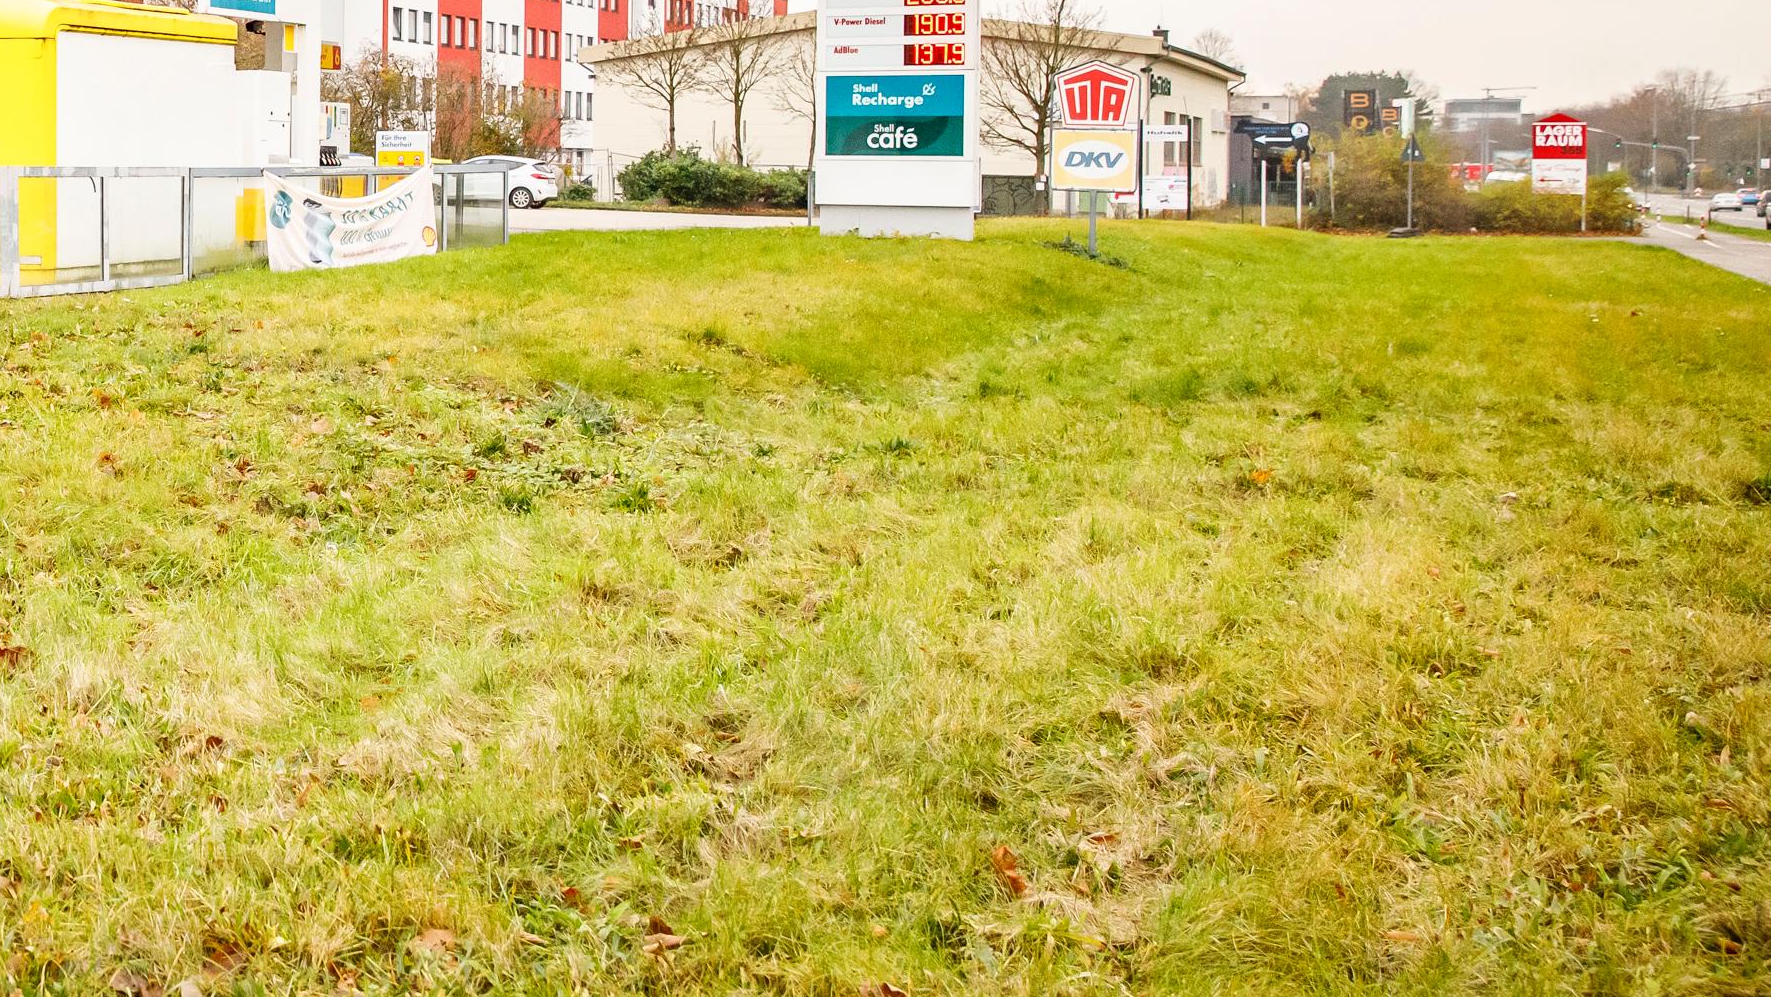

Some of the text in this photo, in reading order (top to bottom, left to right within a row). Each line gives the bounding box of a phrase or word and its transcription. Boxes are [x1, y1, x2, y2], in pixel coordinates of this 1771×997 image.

[864, 17, 886, 25] Diesel
[915, 14, 965, 35] 190.9
[834, 46, 858, 54] AdBlue
[915, 44, 965, 64] 137.9
[334, 51, 340, 65] 6
[853, 84, 878, 93] Shell
[1063, 69, 1129, 121] UTA
[852, 93, 924, 108] Recharge
[874, 124, 895, 132] Shell
[1535, 125, 1583, 136] LAGER
[867, 126, 918, 148] café
[1535, 135, 1583, 147] RAUM
[1064, 151, 1124, 169] DKV
